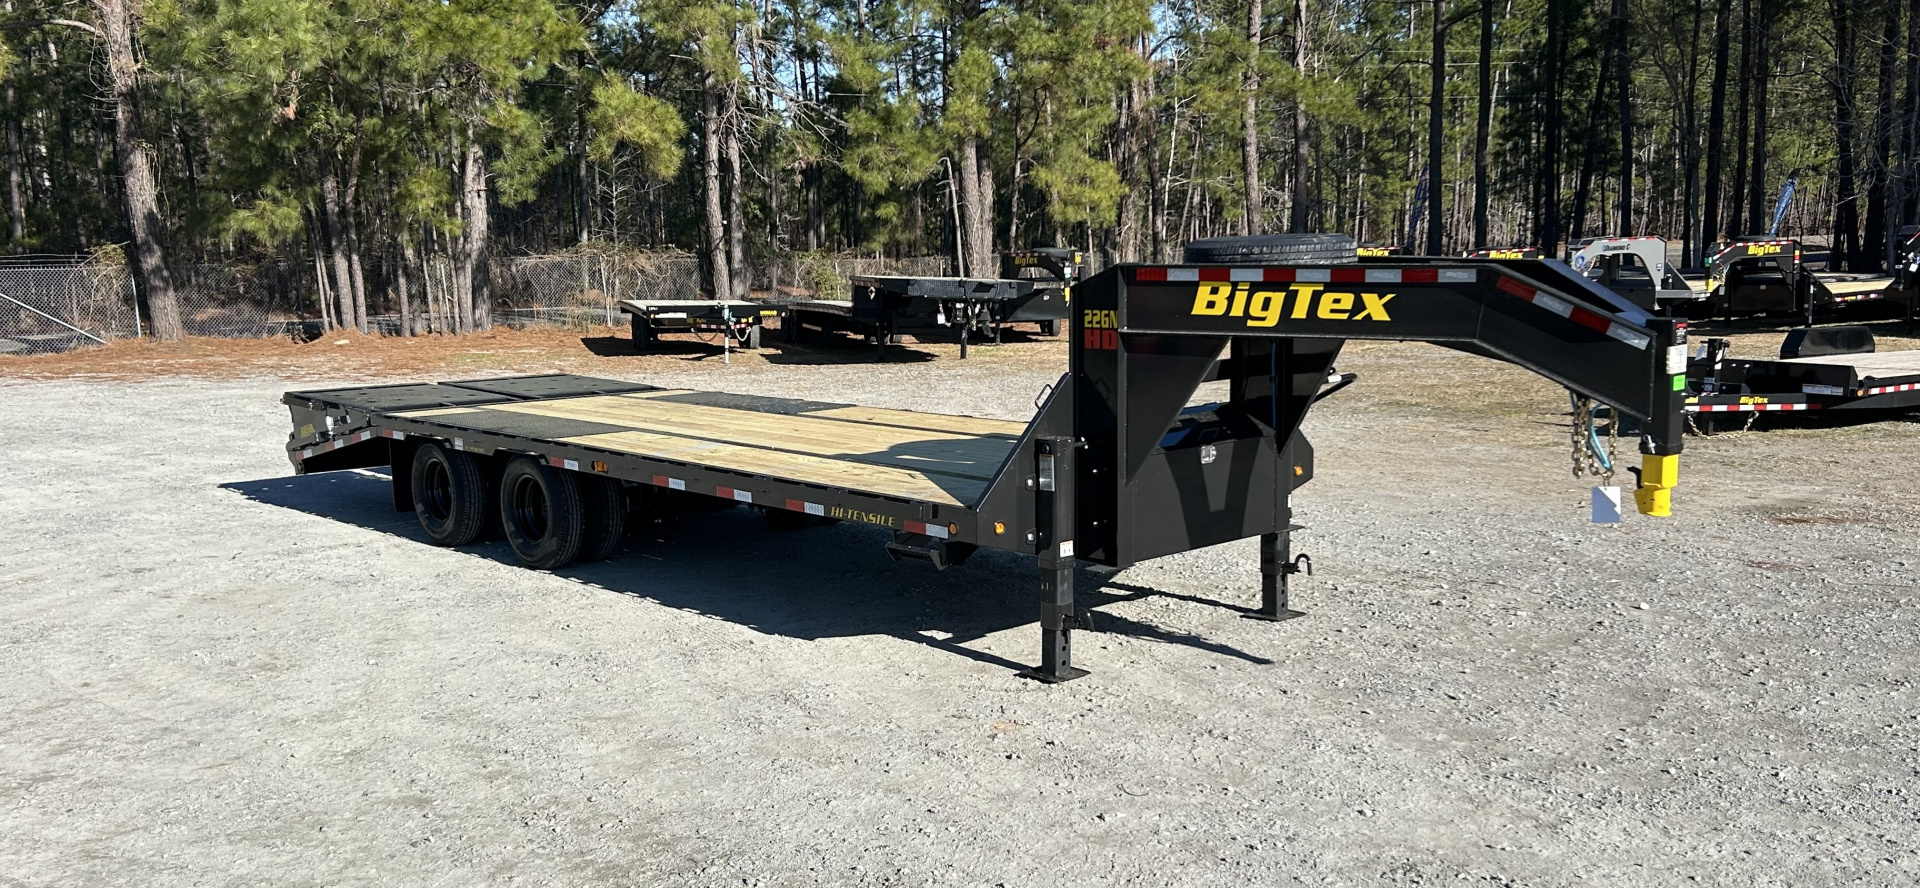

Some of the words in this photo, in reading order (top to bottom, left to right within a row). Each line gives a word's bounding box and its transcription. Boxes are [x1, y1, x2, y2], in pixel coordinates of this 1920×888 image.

[1747, 244, 1781, 256] BigTex
[1015, 255, 1038, 266] BigTex
[1191, 281, 1397, 327] BigTex
[1084, 309, 1118, 328] 22GN
[1084, 329, 1118, 350] HD
[1739, 395, 1768, 405] BigTex
[830, 506, 896, 526] HI-TENSILE
